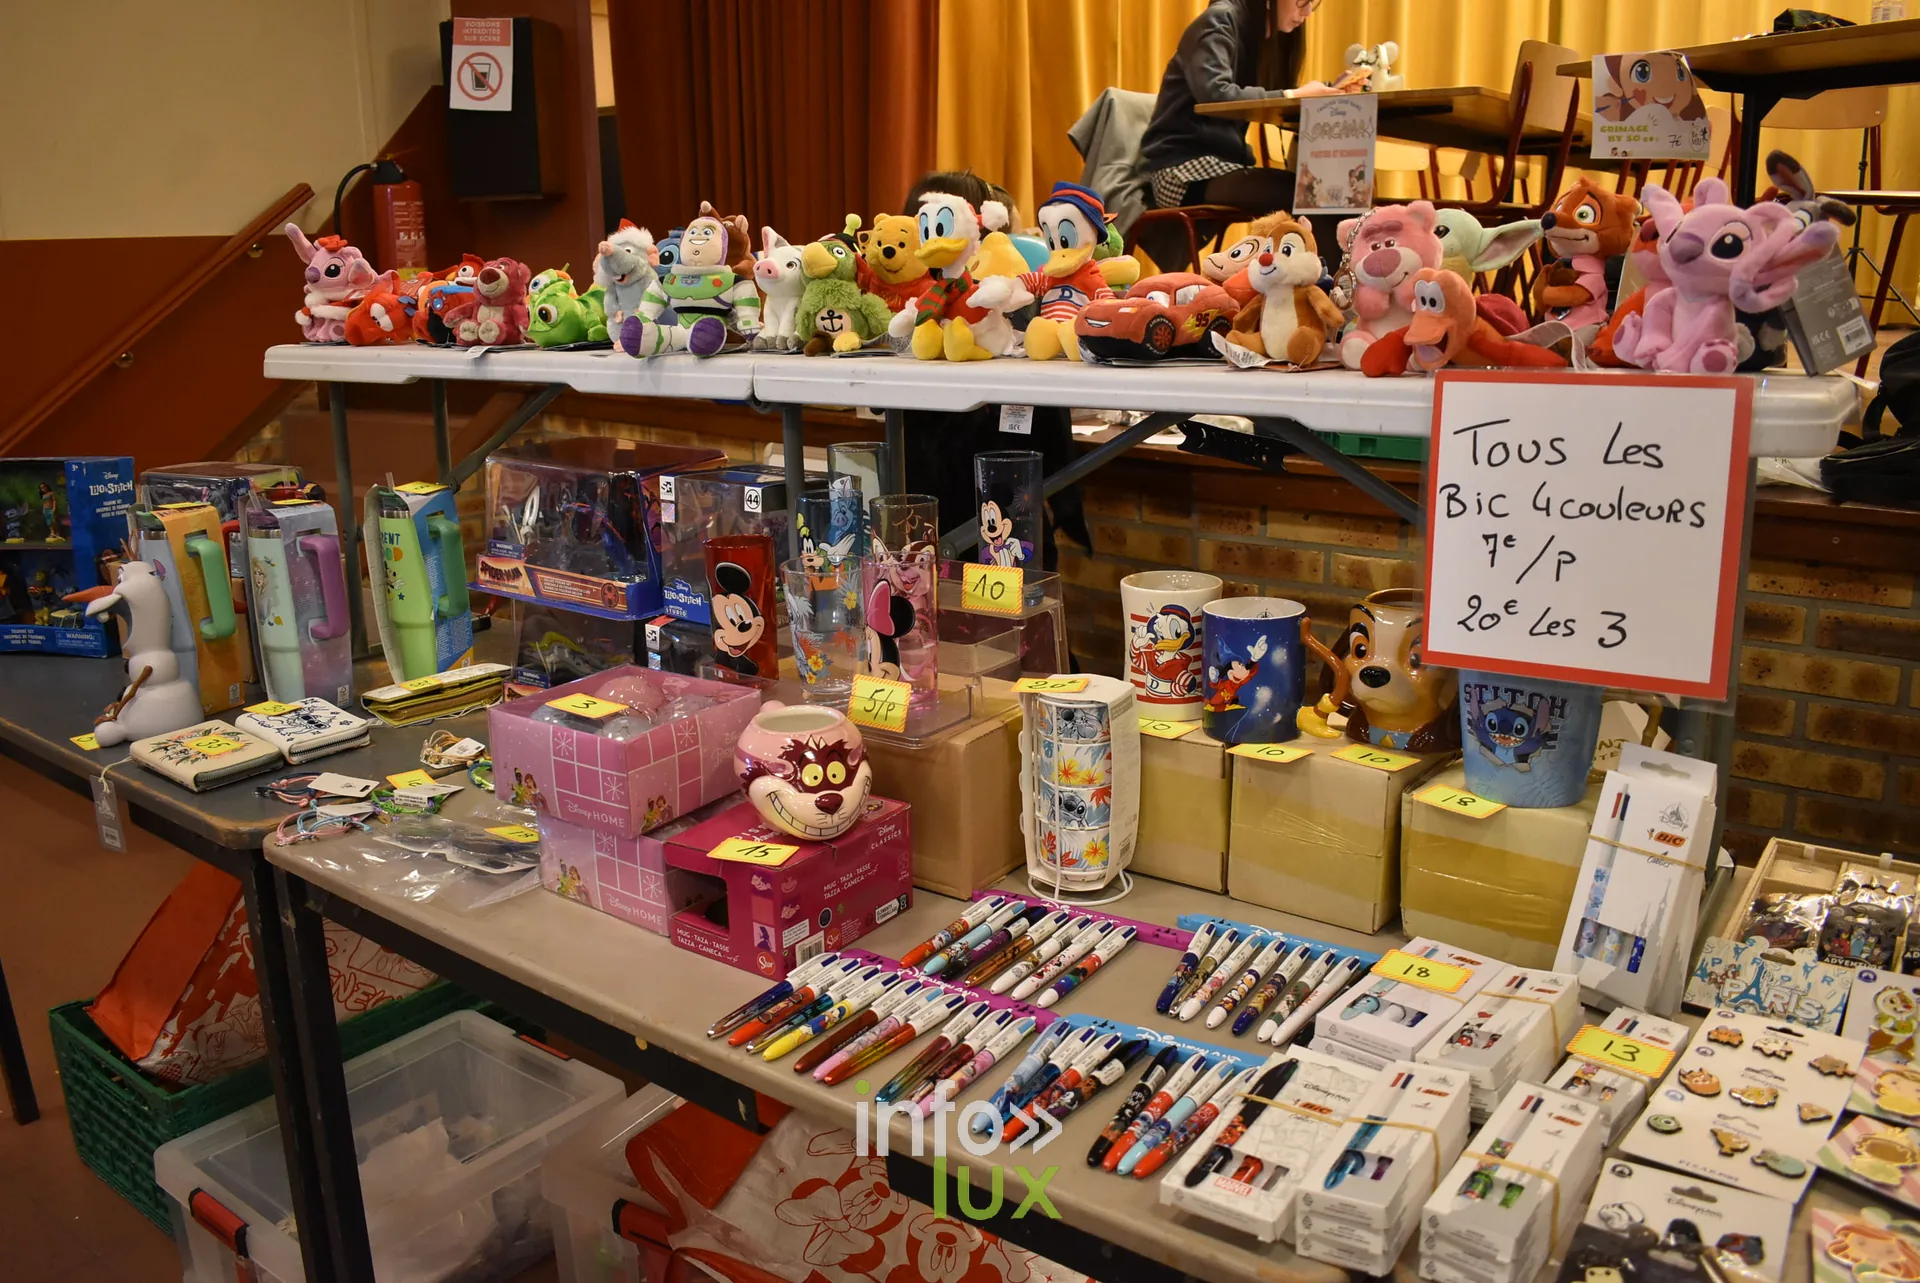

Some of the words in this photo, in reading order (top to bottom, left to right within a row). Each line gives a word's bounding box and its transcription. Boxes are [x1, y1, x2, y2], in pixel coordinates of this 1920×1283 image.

[1600, 125, 1649, 133] GRIMAGE
[1059, 287, 1073, 300] D
[1195, 312, 1210, 327] 95
[661, 481, 673, 494] SG
[746, 494, 759, 505] 44
[973, 573, 1005, 600] 10
[1597, 610, 1628, 649] 3
[1150, 678, 1160, 690] D
[571, 699, 598, 710] 3
[196, 739, 231, 750] 35
[1256, 746, 1285, 757] 10
[1358, 751, 1391, 764] 10
[1441, 793, 1478, 808] 18
[564, 799, 592, 820] Disney
[594, 813, 625, 829] HOME
[1659, 810, 1689, 832] Disney
[876, 824, 896, 837] Disney
[871, 829, 903, 850] CLASSICS
[737, 845, 782, 858] 15
[823, 880, 837, 892] MUG
[840, 871, 853, 884] TAZA
[856, 863, 872, 876] TASSE
[824, 887, 842, 900] TAZZA
[843, 874, 865, 891] CANECA
[605, 893, 632, 915] Disney
[632, 906, 663, 926] HOME
[676, 927, 691, 940] MUG
[694, 933, 709, 947] TAZA
[712, 940, 730, 953] TASSE
[677, 935, 695, 948] TAZZA
[698, 944, 723, 958] CANECA
[1402, 963, 1431, 978] 18
[1602, 1039, 1641, 1063] 13
[1215, 1177, 1252, 1196] MARVEL
